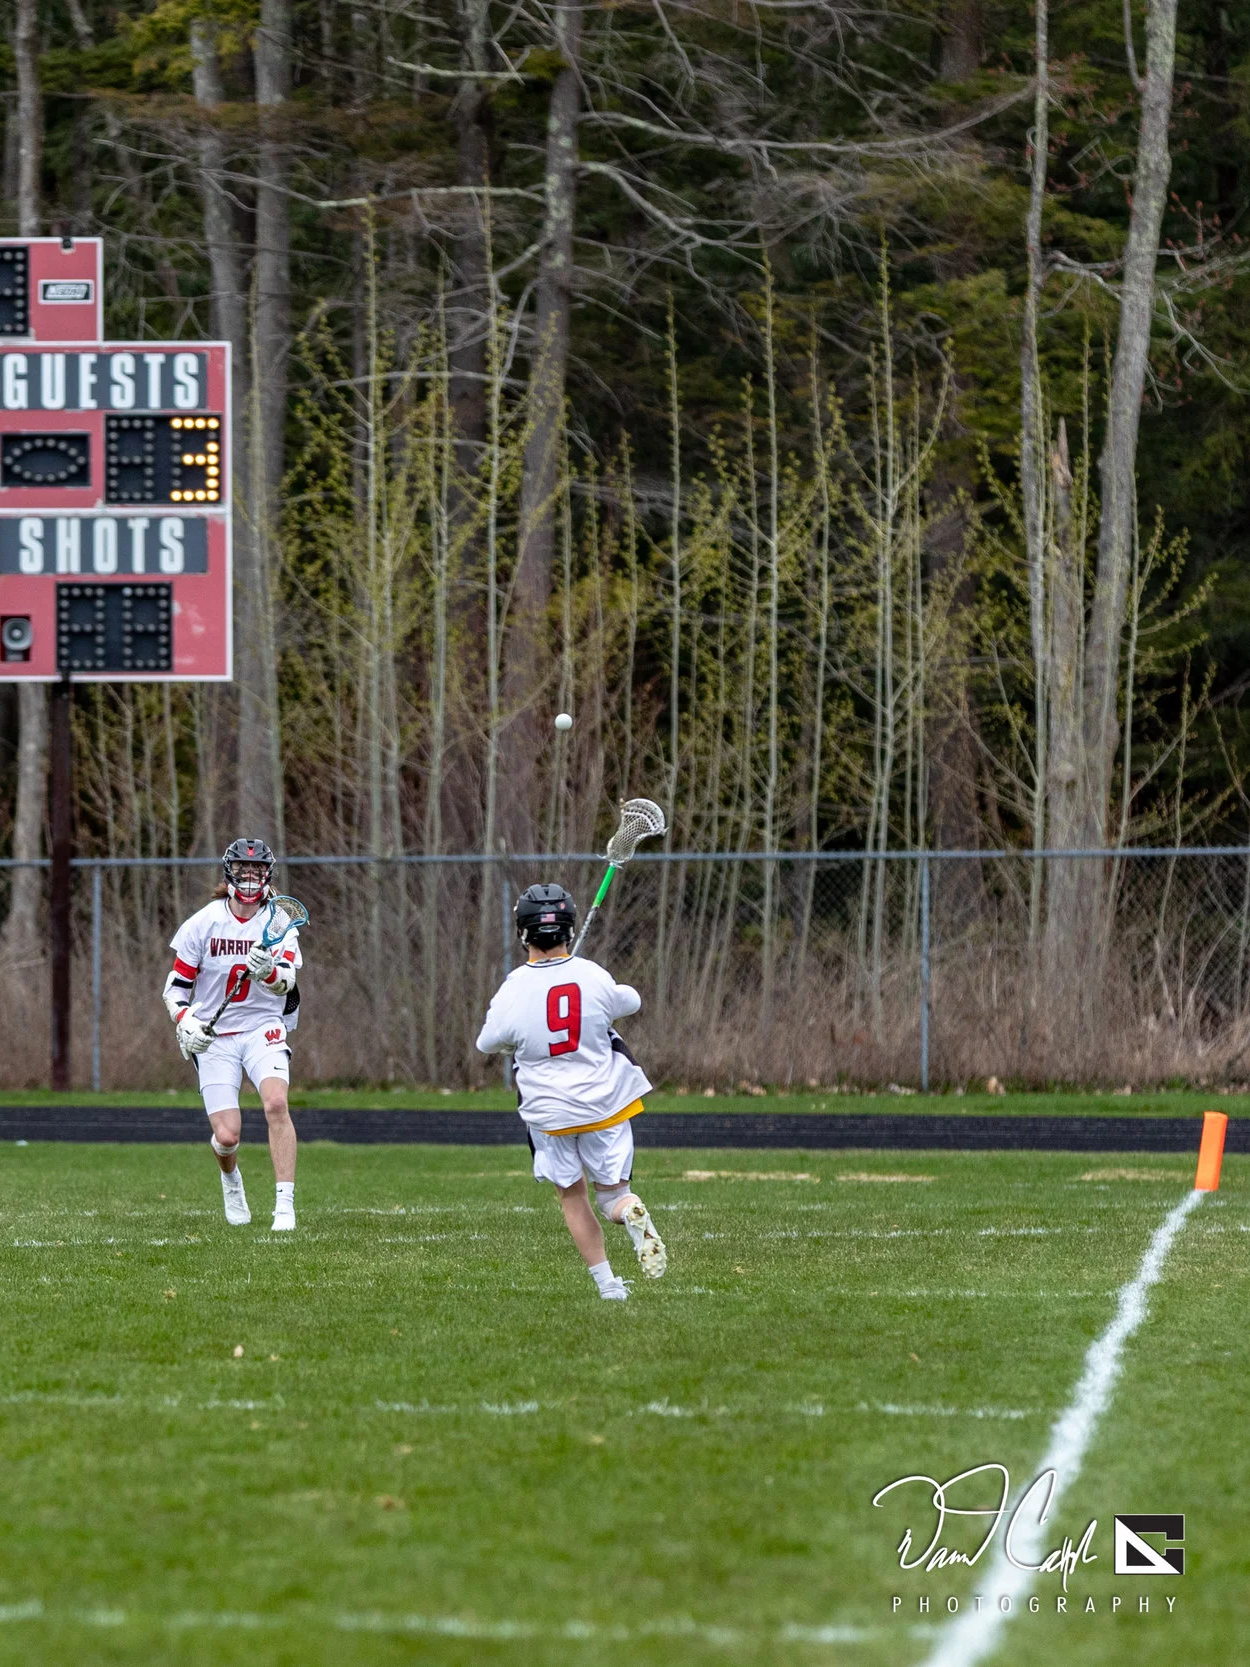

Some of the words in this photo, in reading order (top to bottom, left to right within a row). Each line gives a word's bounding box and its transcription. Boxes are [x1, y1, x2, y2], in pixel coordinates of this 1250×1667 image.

[3, 351, 200, 410] GUESTS
[169, 416, 220, 502] 3
[18, 517, 185, 575] SHOTS
[546, 982, 582, 1058] 9
